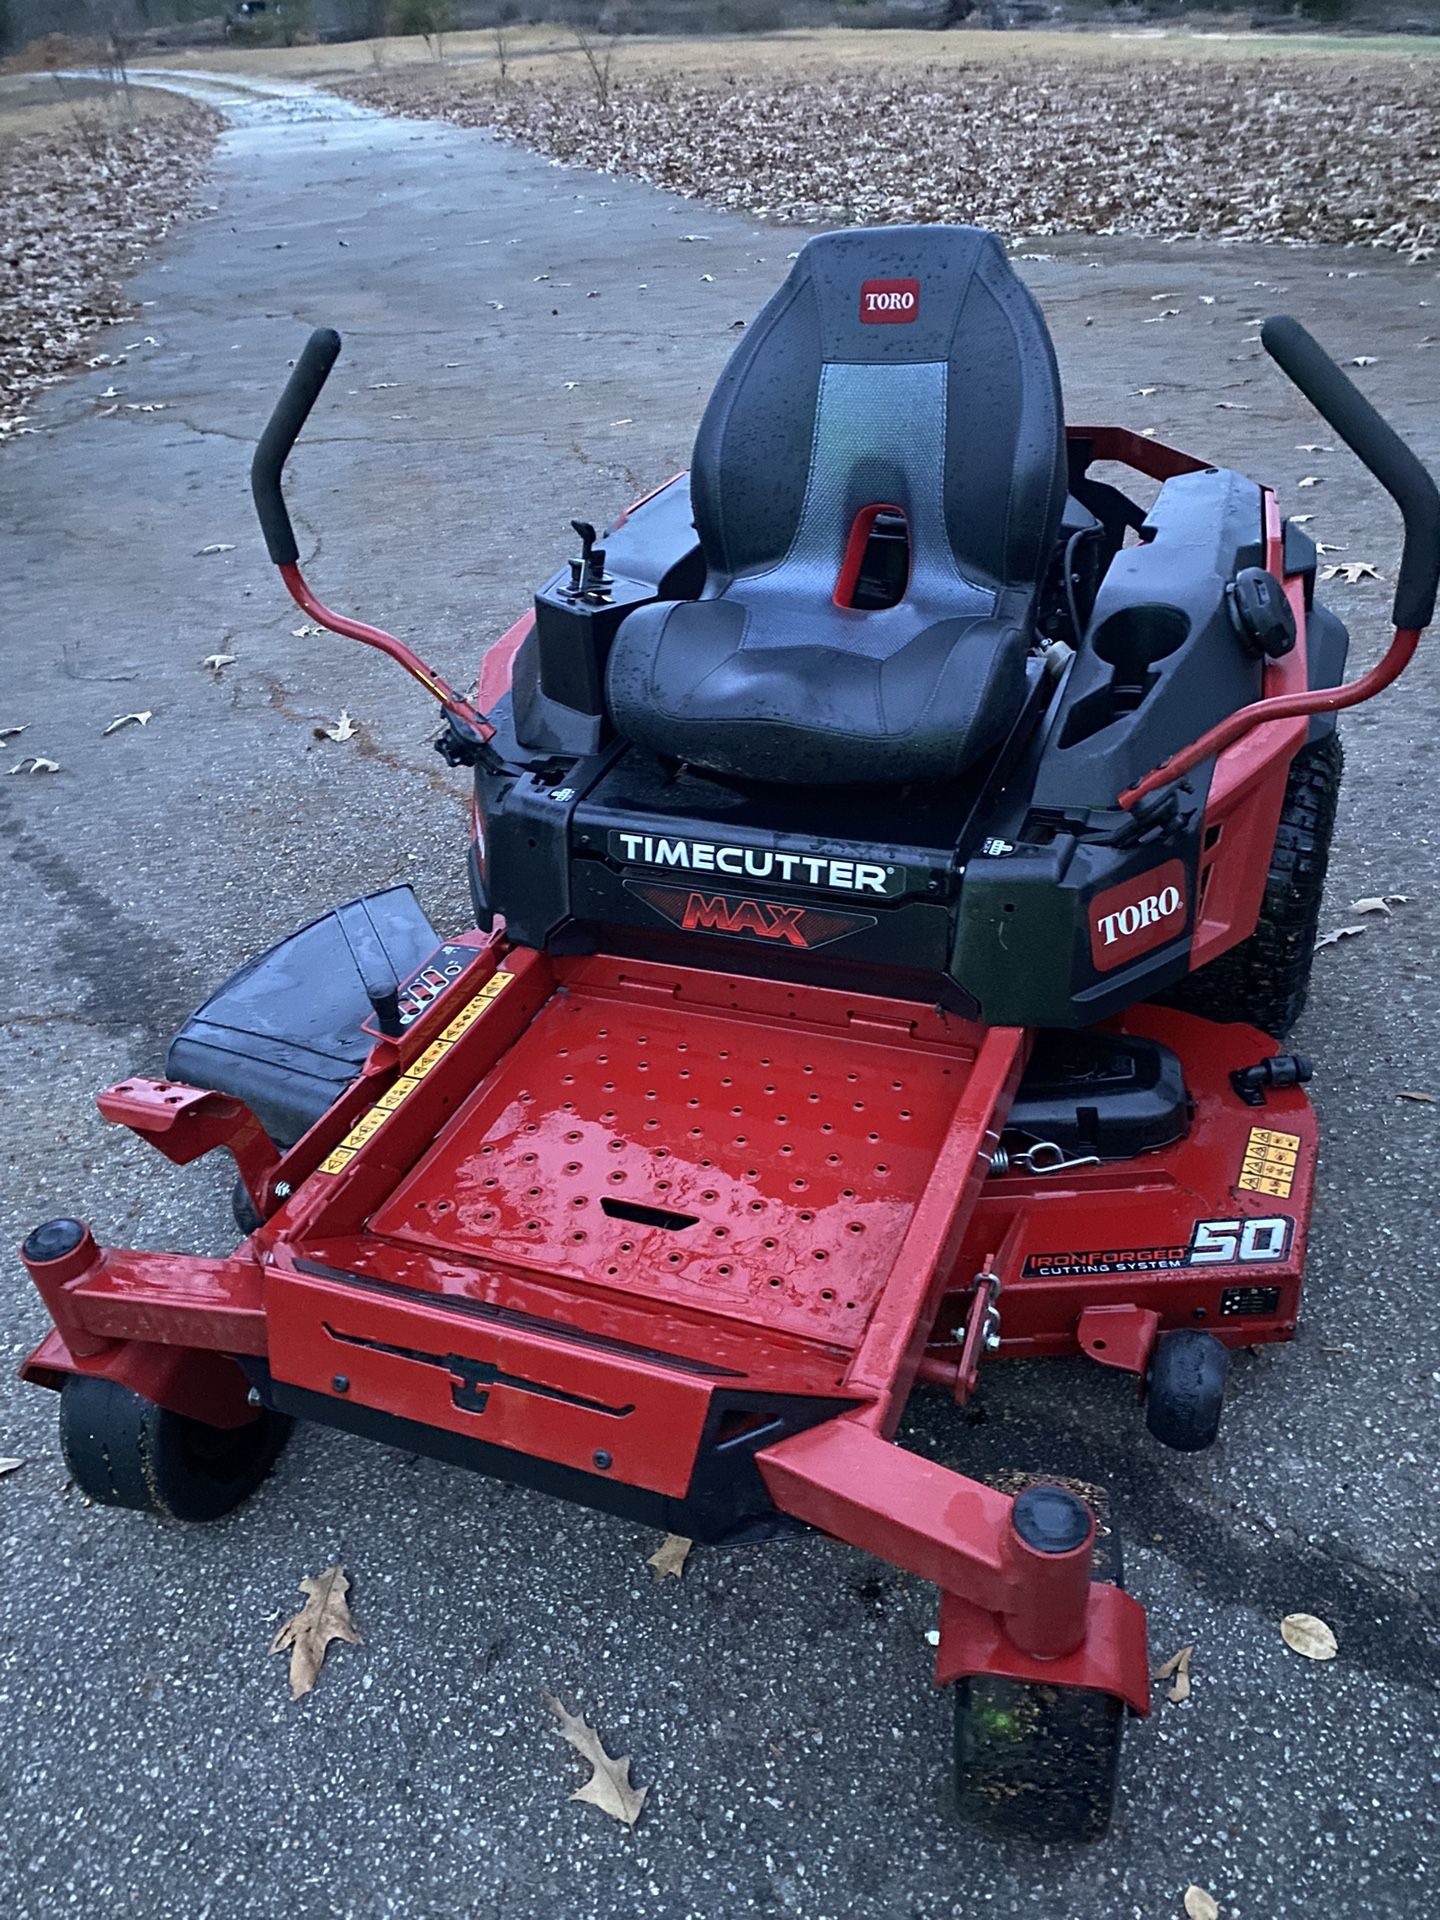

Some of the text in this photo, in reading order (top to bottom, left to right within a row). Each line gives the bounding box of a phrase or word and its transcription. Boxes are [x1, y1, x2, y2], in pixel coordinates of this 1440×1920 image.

[866, 292, 914, 310] TORO
[682, 893, 809, 947] MAX
[1097, 886, 1180, 946] TORO
[1190, 1219, 1287, 1264] 50
[1039, 1260, 1181, 1275] CUTTING SYSTEM
